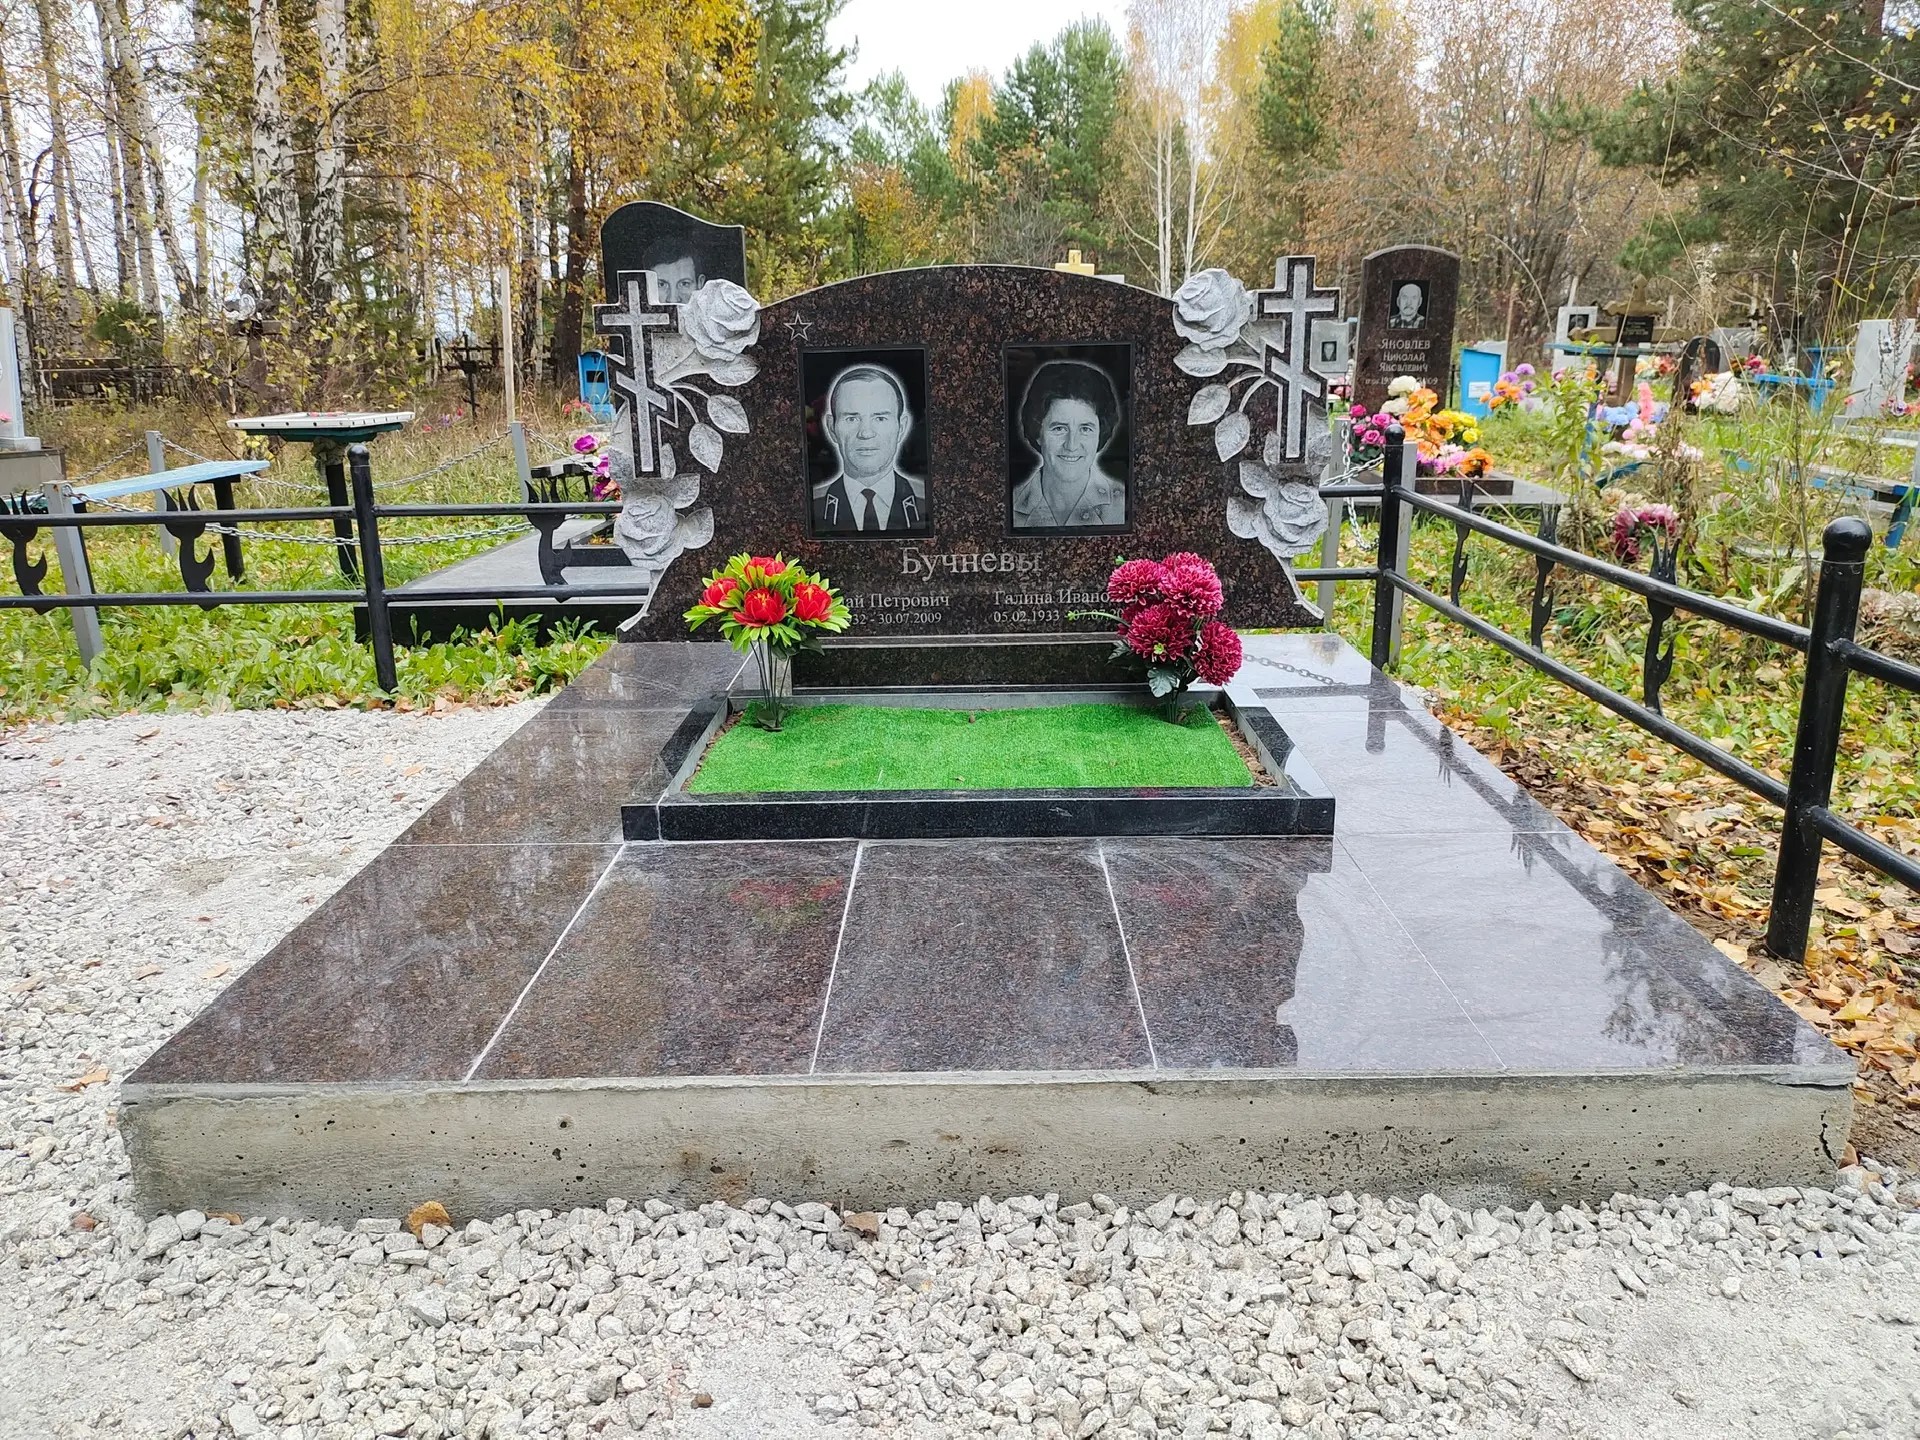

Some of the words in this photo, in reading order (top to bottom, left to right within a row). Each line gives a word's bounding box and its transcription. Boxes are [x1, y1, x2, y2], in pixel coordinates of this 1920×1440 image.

[1380, 338, 1431, 350] ЯКОВЛЕВ
[1383, 351, 1426, 361] НИКОЛАЙ
[900, 547, 1043, 582] Бучневы
[870, 593, 950, 611] Петрович
[993, 591, 1053, 606] Галина
[1058, 589, 1138, 604] Ивано
[878, 612, 942, 624] 30.07.2009
[993, 610, 1060, 623] 05.02.1933
